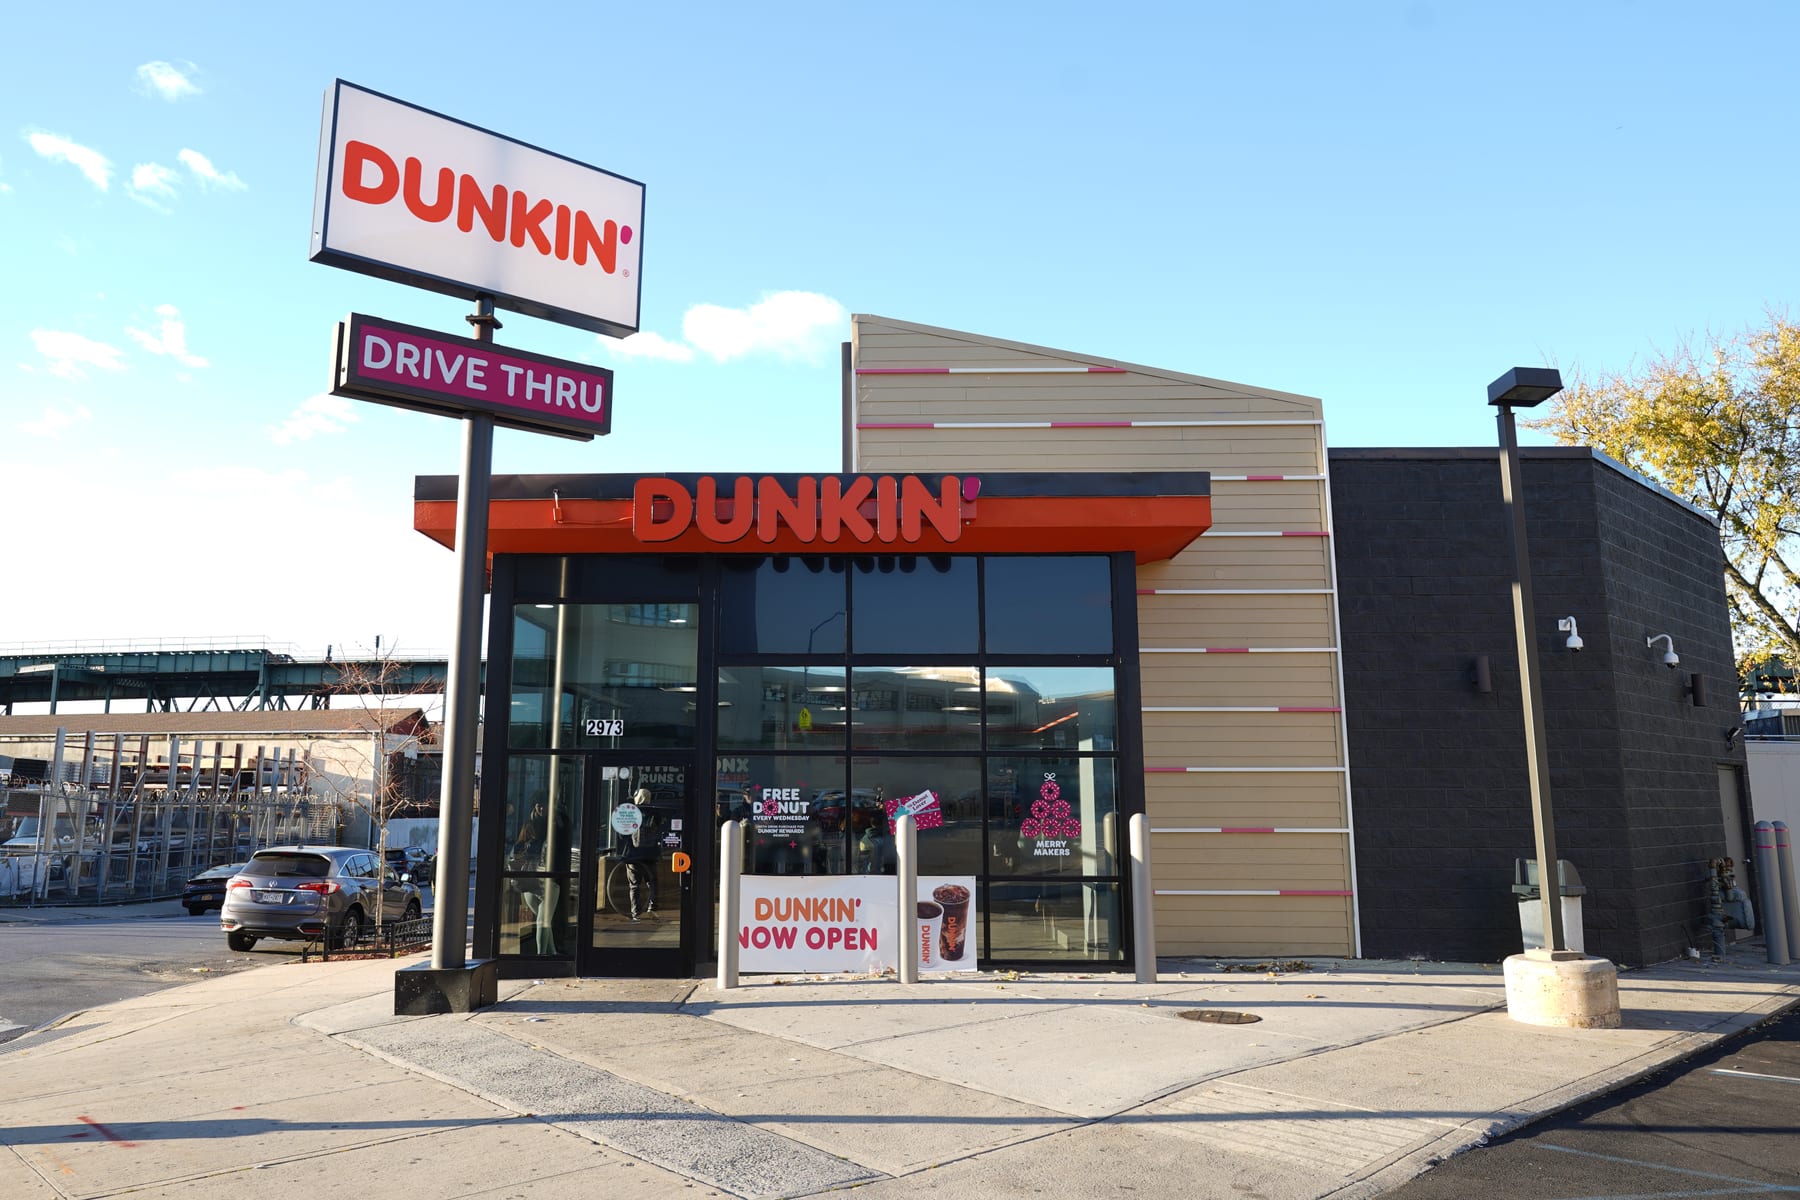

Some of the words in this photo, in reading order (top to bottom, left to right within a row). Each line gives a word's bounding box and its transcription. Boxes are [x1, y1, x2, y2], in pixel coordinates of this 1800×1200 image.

[342, 140, 632, 274] DUNKIN'
[363, 335, 489, 391] DRIVE
[500, 363, 603, 413] THRU
[633, 475, 981, 543] DUNKIN'
[587, 720, 623, 735] 2973
[716, 758, 748, 773] NX
[640, 773, 674, 783] RUNS
[762, 788, 800, 801] FREE
[753, 800, 810, 816] DONUT
[1033, 848, 1070, 856] MAKERS
[1036, 840, 1067, 848] MERRY
[671, 852, 691, 873] D
[755, 897, 862, 922] DUNKIN'
[739, 926, 798, 950] NOW
[805, 927, 878, 950] OPEN
